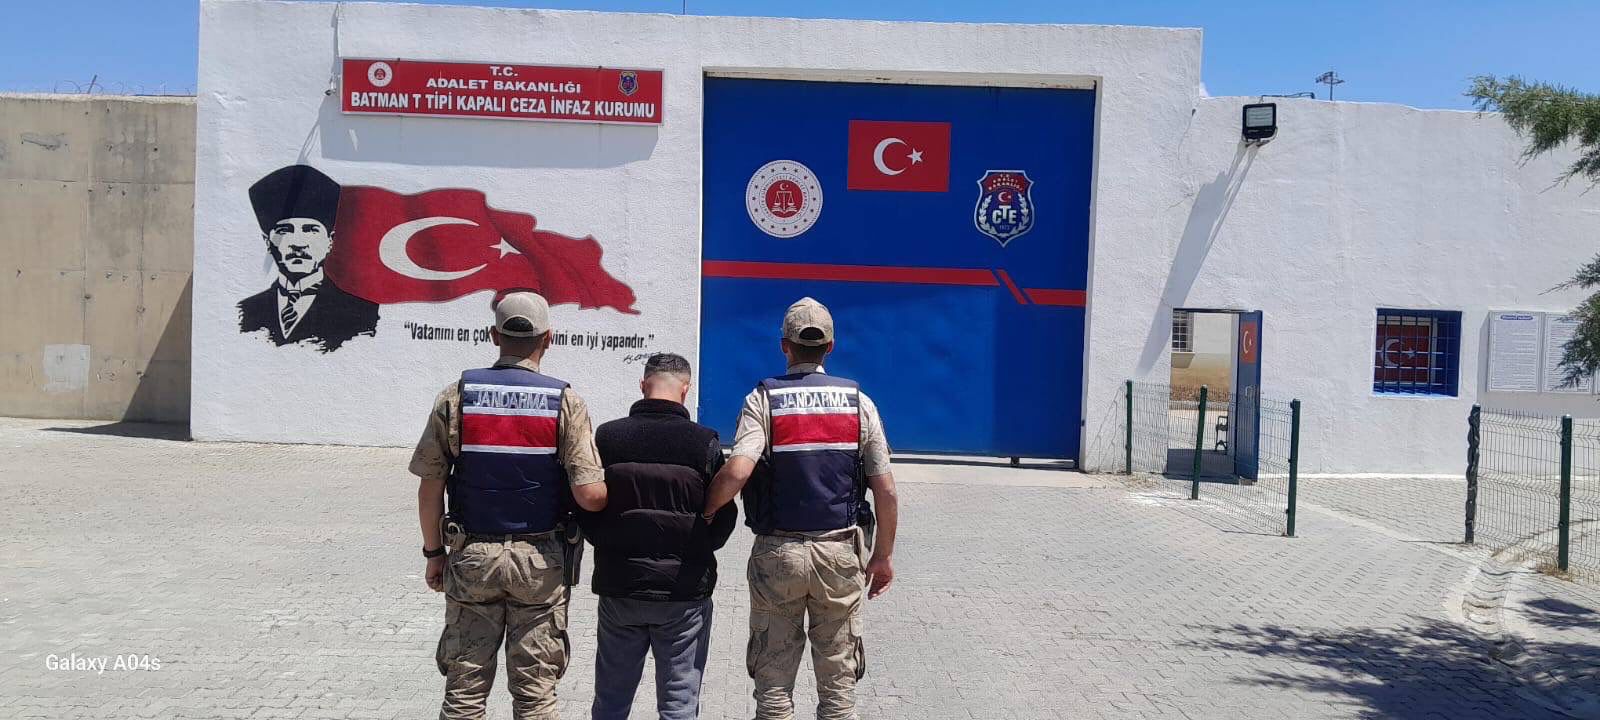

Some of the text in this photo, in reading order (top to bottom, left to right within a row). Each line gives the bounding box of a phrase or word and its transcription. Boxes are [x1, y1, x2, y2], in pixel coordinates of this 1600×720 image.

[490, 66, 518, 77] T.C.
[426, 78, 581, 94] ADALET BAKANLIĞI
[351, 91, 655, 118] BATMAN T TİPİ KAPALI CEZA İNFAZ KURUMU
[992, 205, 1017, 225] CTE
[457, 327, 470, 342] en
[549, 330, 568, 346] vini
[571, 332, 584, 347] en
[586, 331, 598, 350] iyi
[473, 390, 549, 410] JANDARMA
[780, 391, 850, 409] JANDARMA
